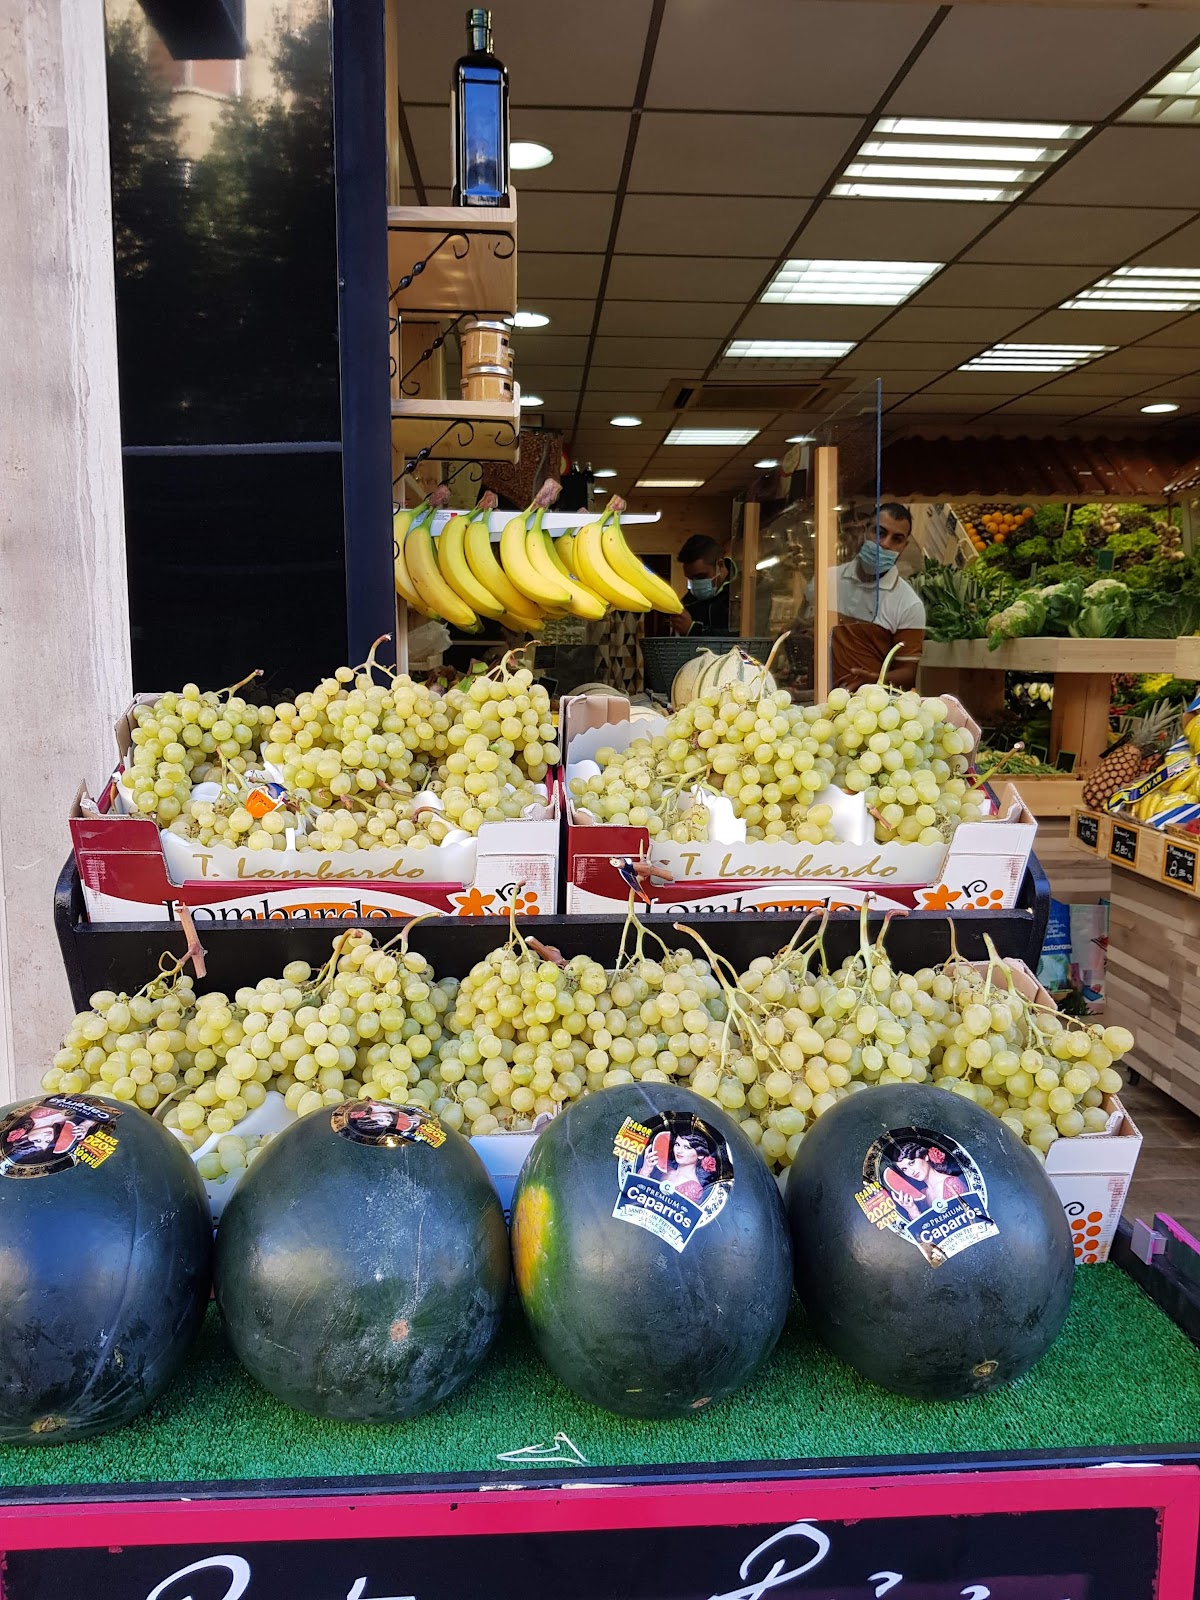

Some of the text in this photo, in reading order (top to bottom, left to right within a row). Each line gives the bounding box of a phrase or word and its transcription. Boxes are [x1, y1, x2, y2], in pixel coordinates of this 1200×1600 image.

[193, 853, 425, 879] T. Lombardo
[679, 853, 898, 878] T. Lombardo
[94, 1130, 119, 1146] 2019
[629, 1120, 652, 1136] SABOR
[83, 1135, 116, 1154] 2020
[613, 1146, 637, 1163] 2019
[614, 1135, 646, 1155] 2020
[627, 1186, 692, 1228] Caparrós
[645, 1186, 680, 1209] PREMIUM
[867, 1197, 896, 1223] 2020
[877, 1211, 898, 1230] 2019
[929, 1204, 963, 1226] PREMIUM
[920, 1206, 982, 1243] Caparrós
